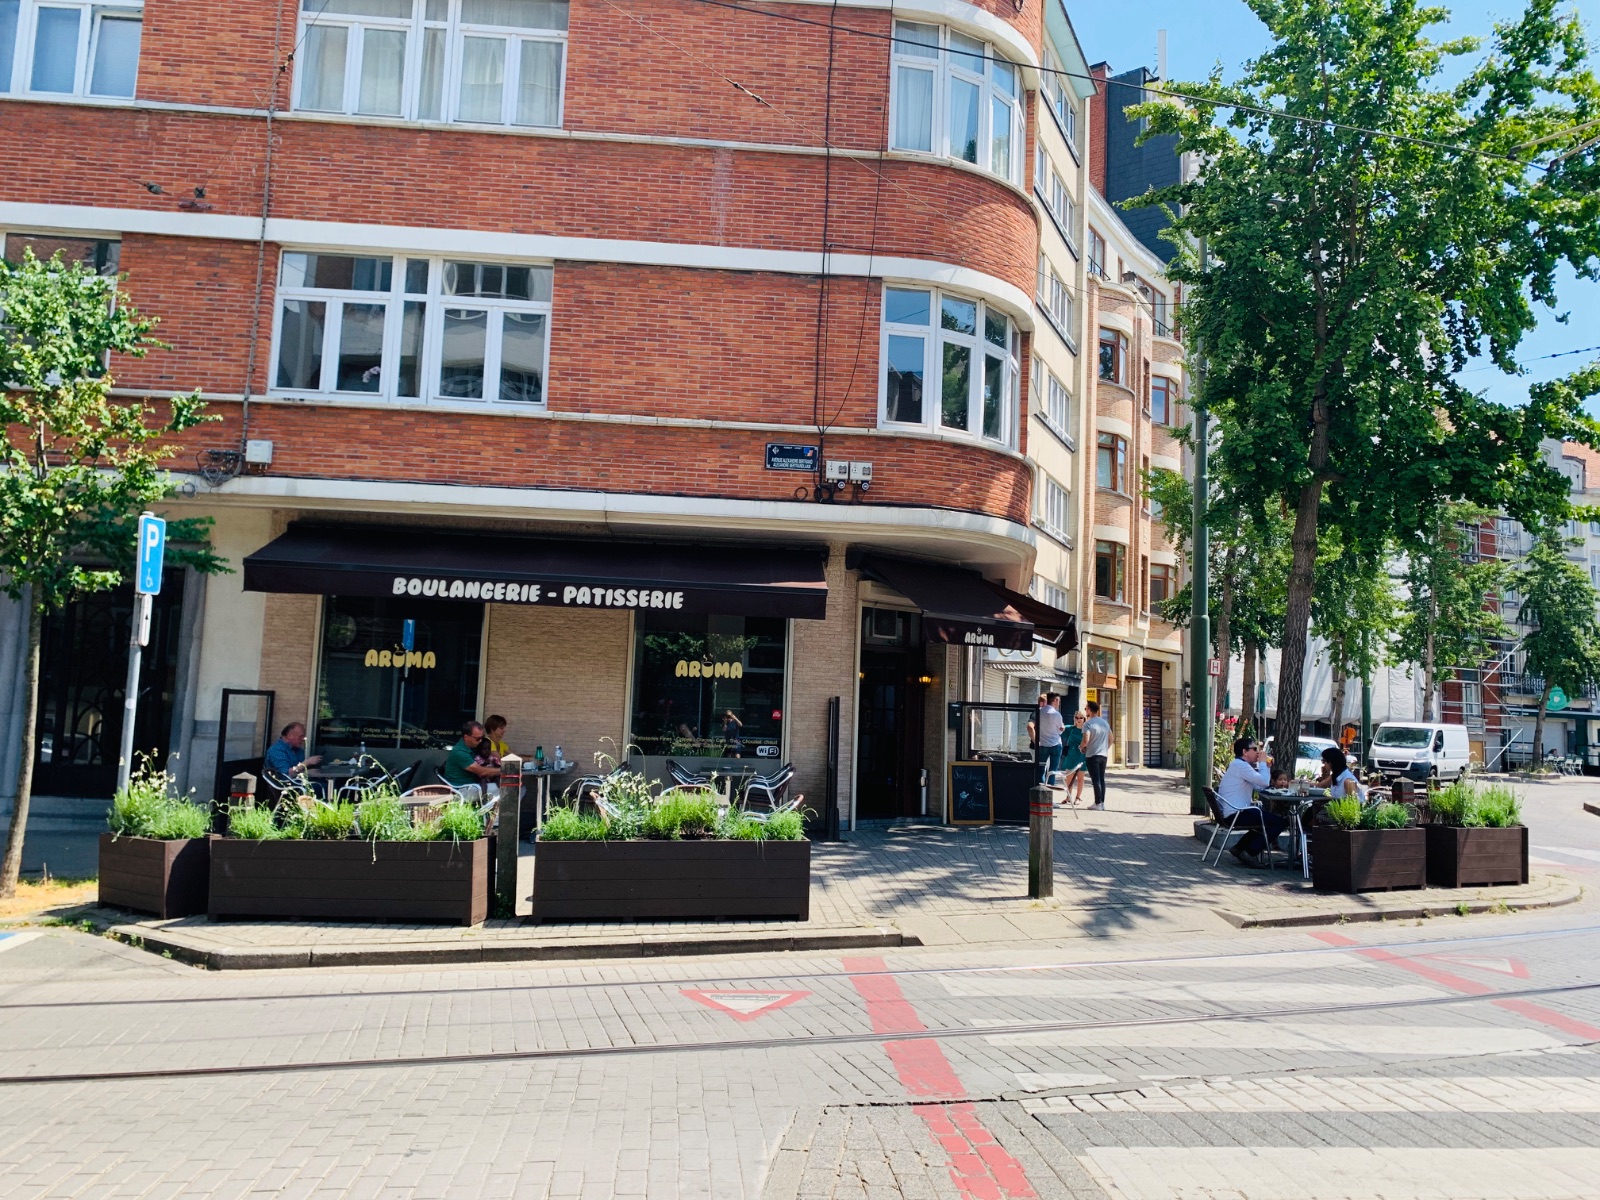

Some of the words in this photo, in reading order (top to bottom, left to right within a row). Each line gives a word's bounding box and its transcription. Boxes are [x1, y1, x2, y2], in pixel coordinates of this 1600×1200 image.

[145, 523, 160, 562] P
[392, 577, 541, 602] BOULANGERIE
[563, 586, 684, 609] PATISSERIE
[364, 648, 436, 669] AROMA
[1212, 661, 1219, 673] H
[675, 660, 743, 679] AROMA
